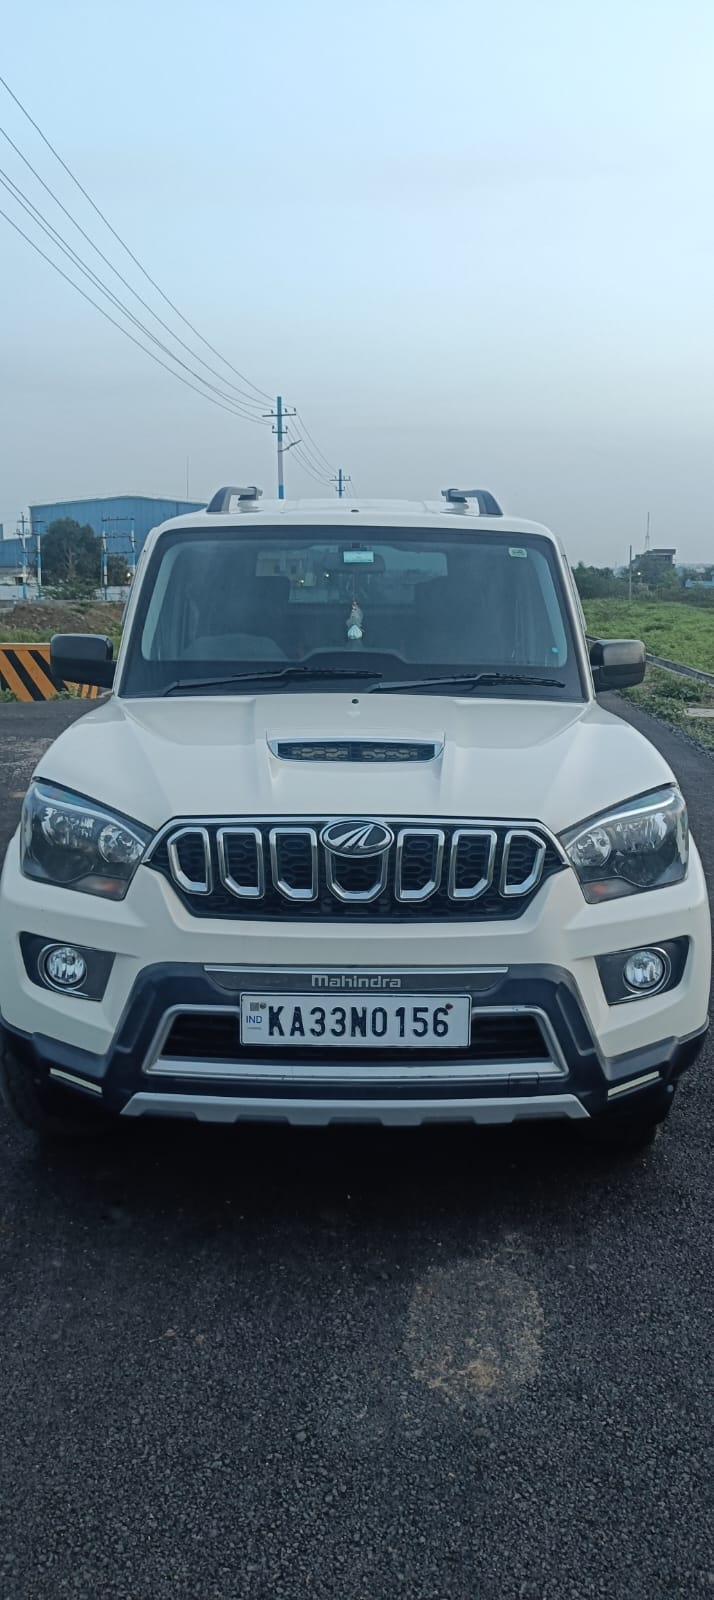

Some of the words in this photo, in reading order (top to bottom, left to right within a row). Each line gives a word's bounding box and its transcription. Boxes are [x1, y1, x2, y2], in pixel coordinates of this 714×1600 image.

[311, 974, 401, 988] Mahindra
[246, 1015, 262, 1024] IND
[268, 1006, 449, 1038] KA33N0156
